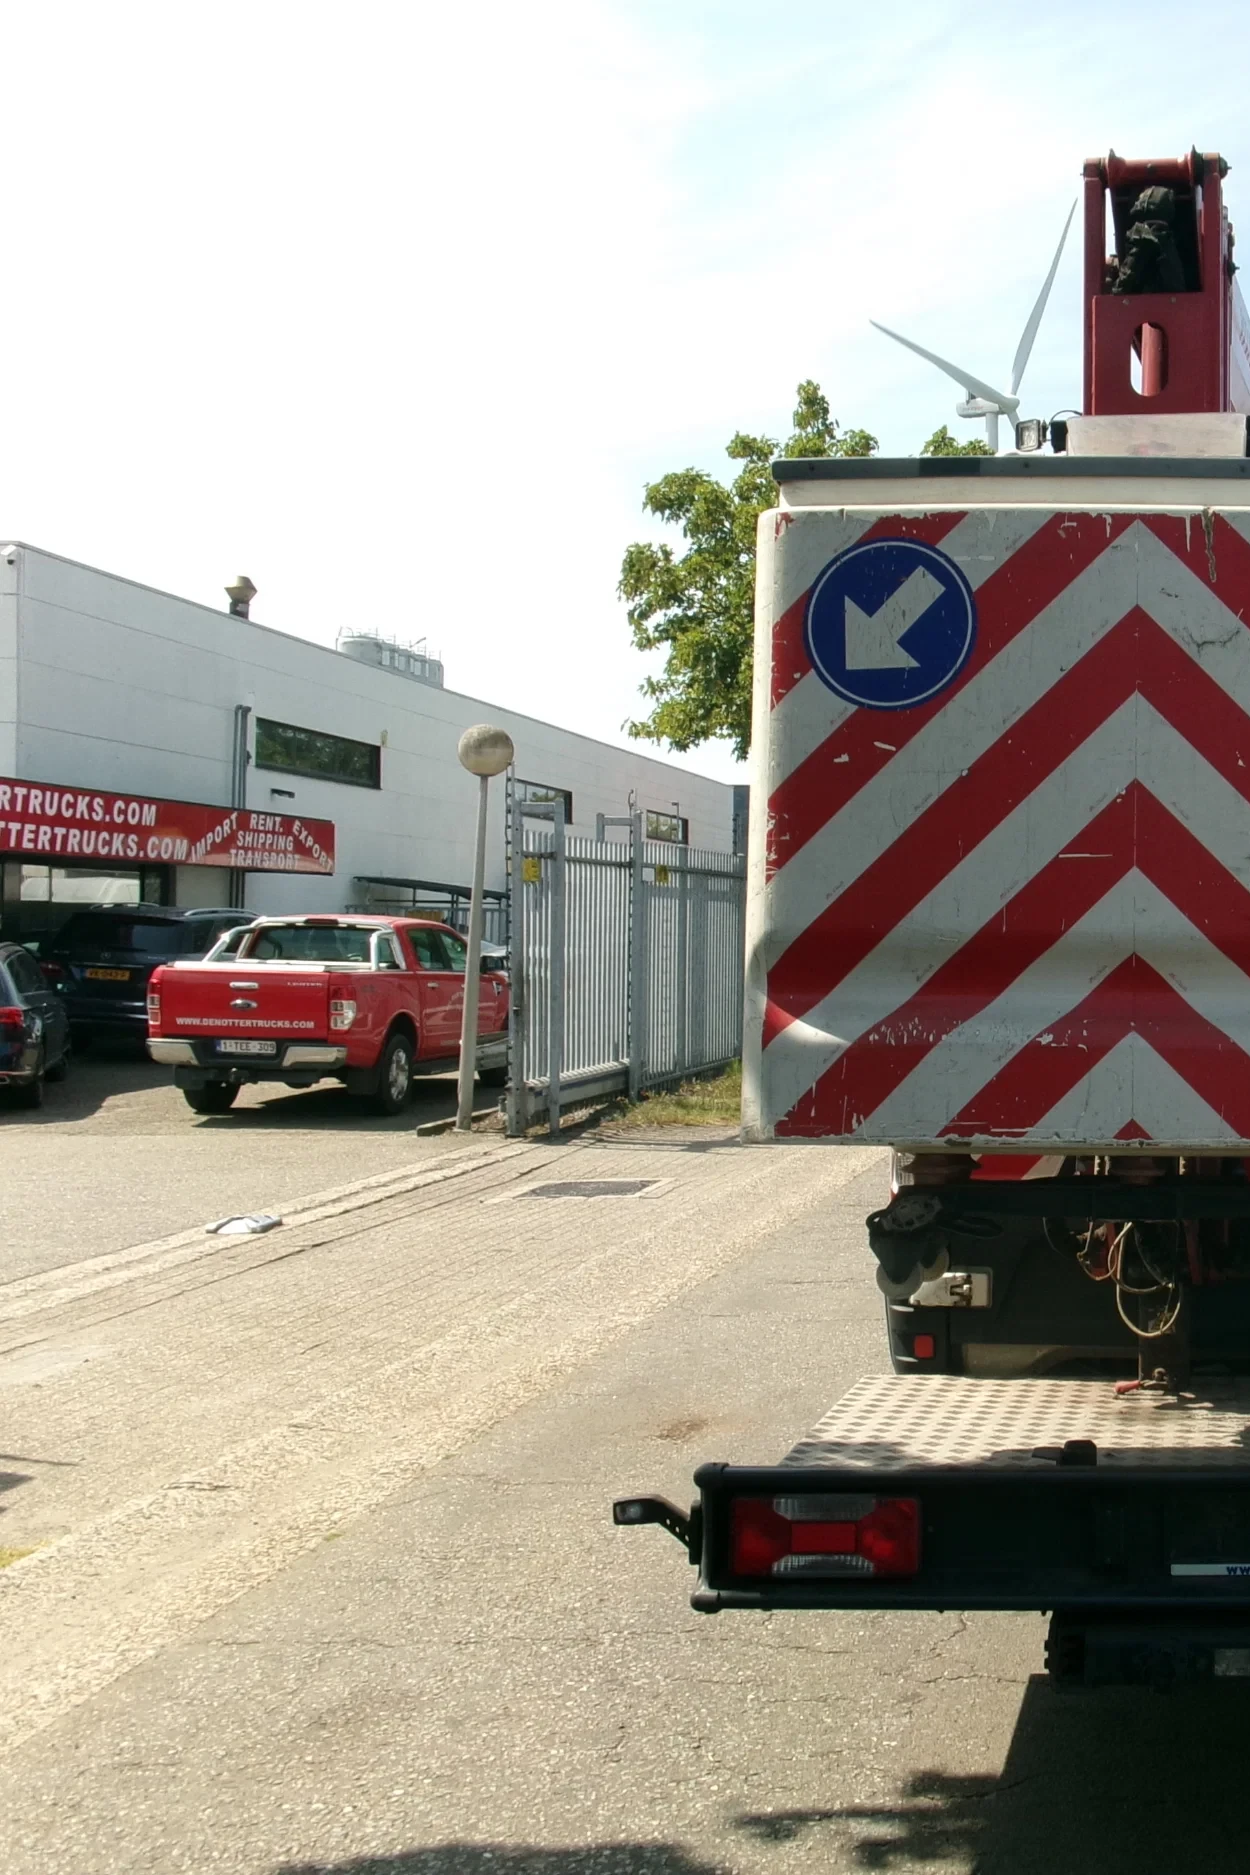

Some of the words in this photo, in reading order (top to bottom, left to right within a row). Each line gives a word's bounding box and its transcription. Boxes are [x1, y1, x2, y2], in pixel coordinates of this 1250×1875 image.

[0, 784, 157, 827] RTRUCKS.COM
[190, 811, 238, 863] IMPORT
[236, 831, 294, 851] SHIPPING
[292, 820, 334, 872] EXPORT
[229, 849, 300, 870] TRANSPORT
[176, 1017, 315, 1029] WWW.DENOTTERTRUCKS.COM
[222, 1040, 276, 1052] 1-TEE-309
